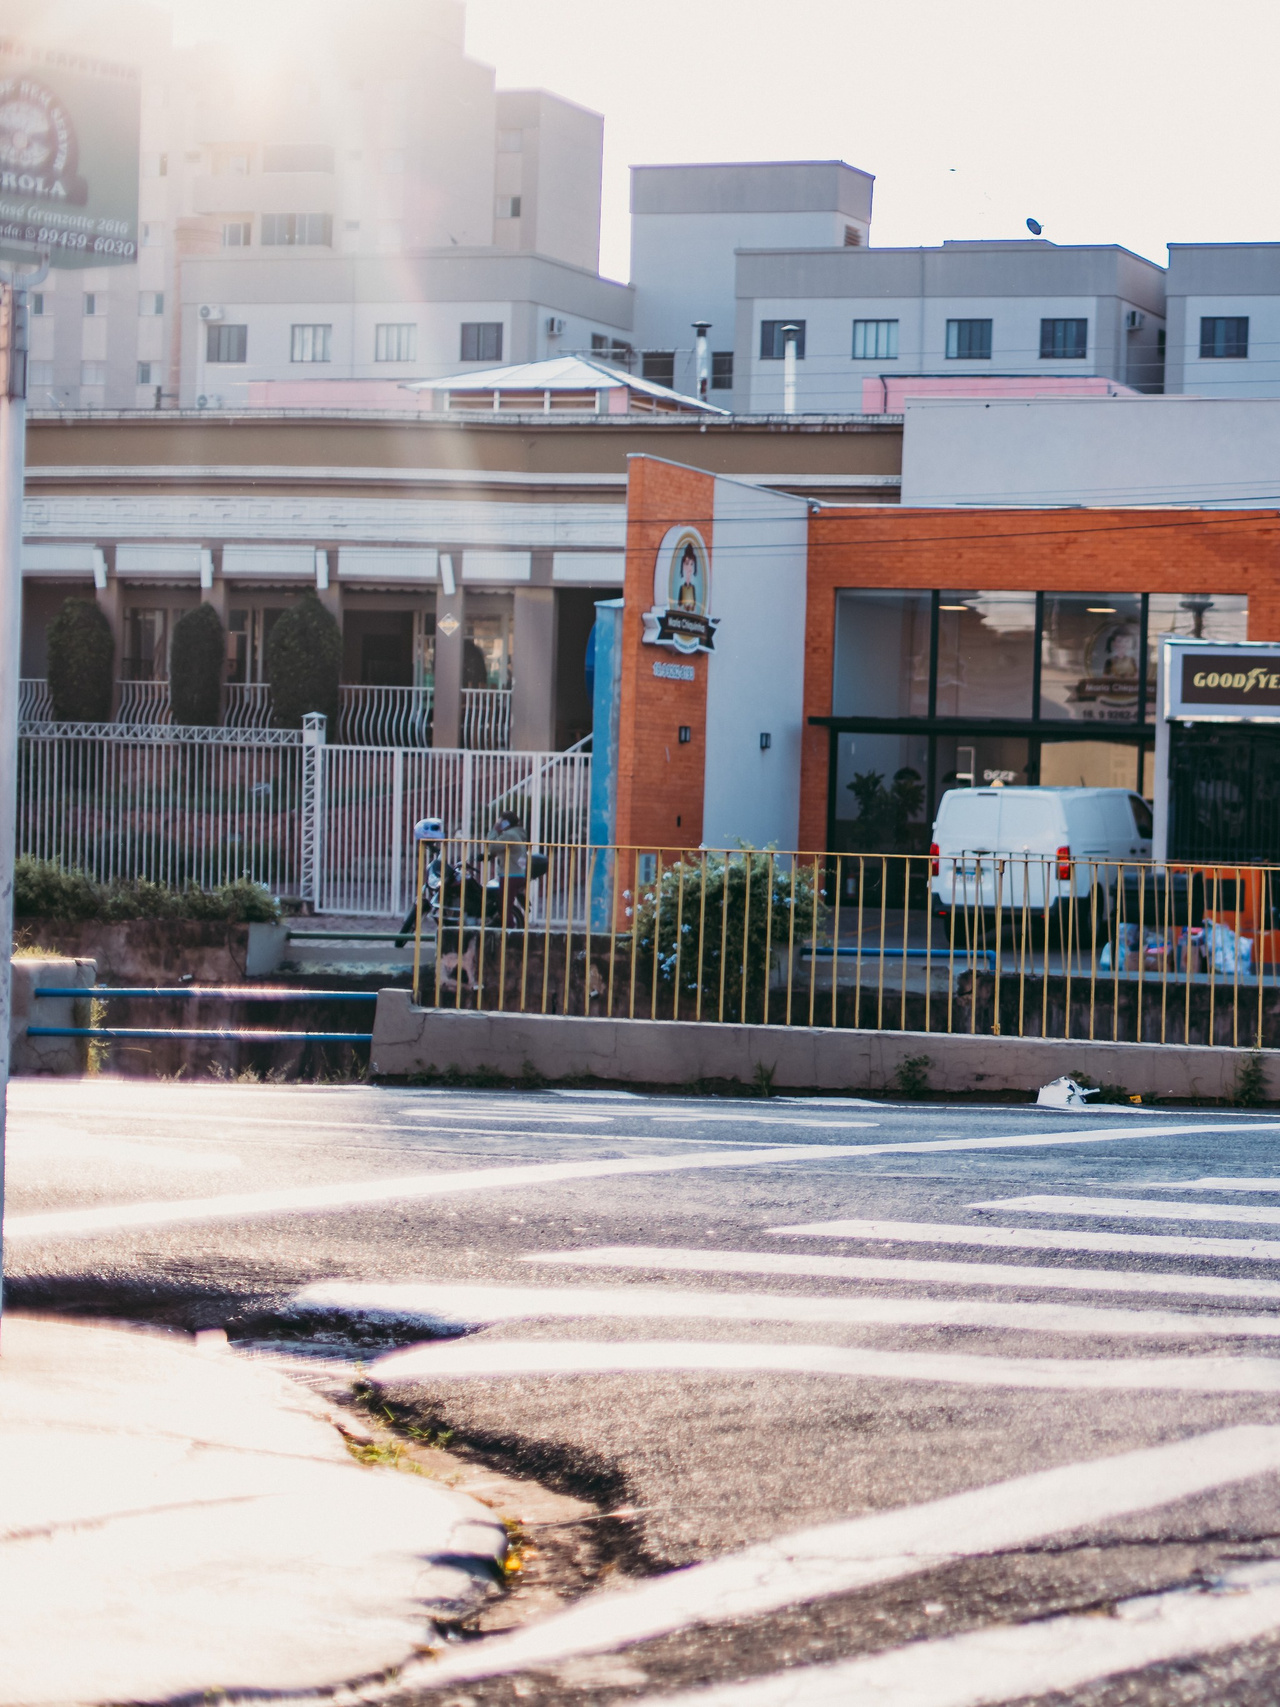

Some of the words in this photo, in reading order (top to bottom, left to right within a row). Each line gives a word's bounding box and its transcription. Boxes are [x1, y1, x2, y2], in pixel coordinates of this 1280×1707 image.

[0, 171, 67, 196] ROLA
[97, 218, 129, 234] 2616
[37, 227, 135, 256] 99459-6030
